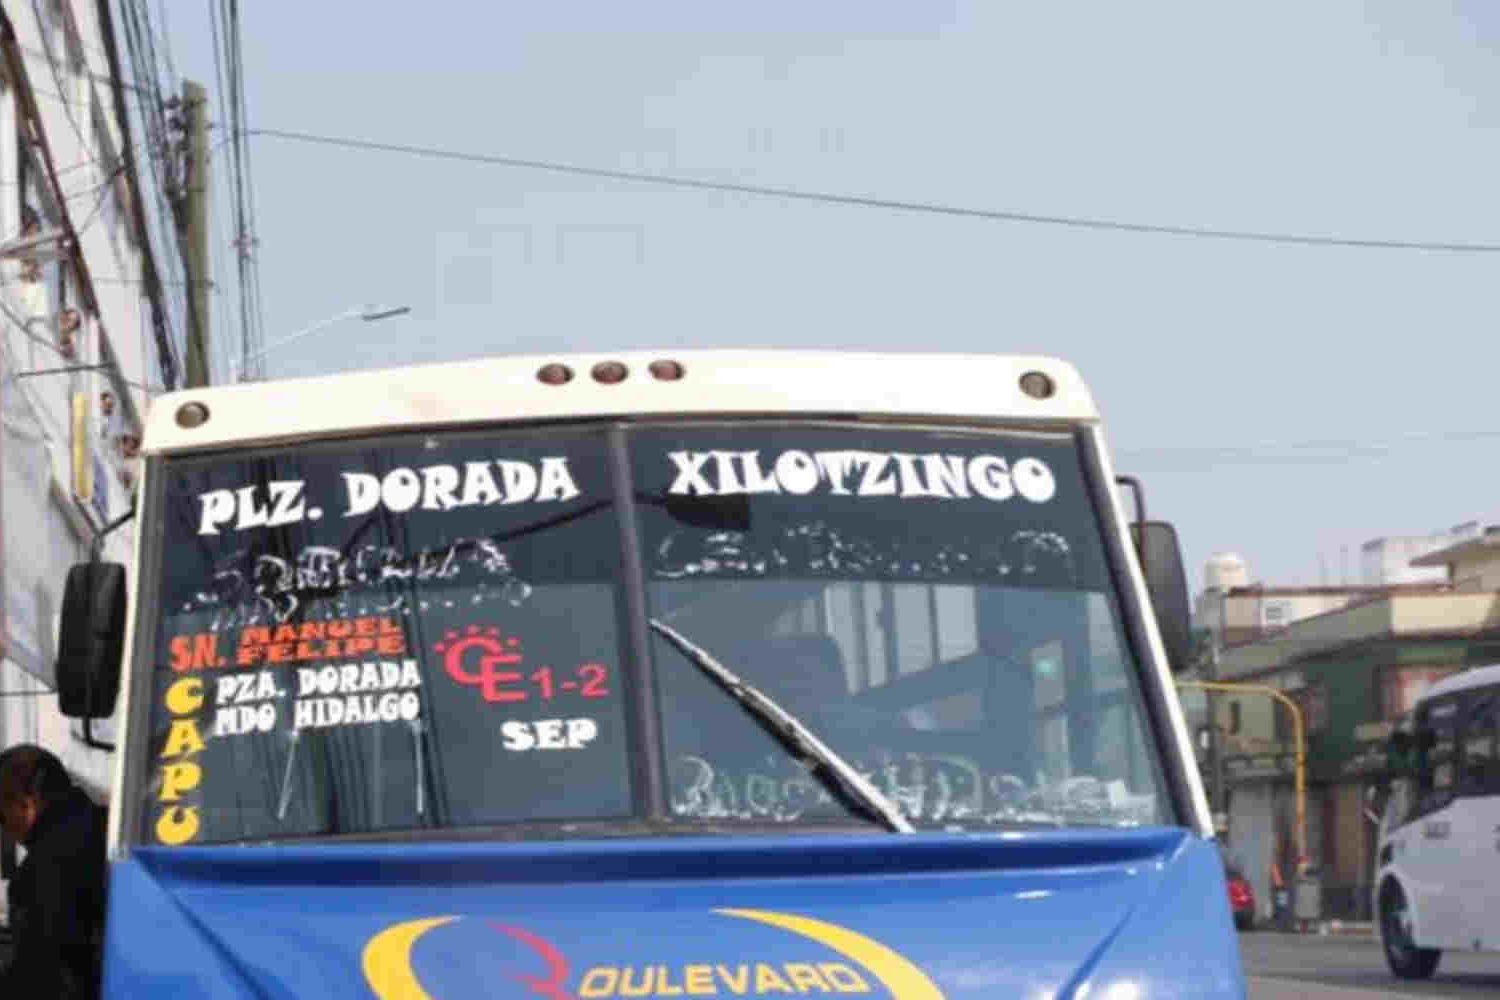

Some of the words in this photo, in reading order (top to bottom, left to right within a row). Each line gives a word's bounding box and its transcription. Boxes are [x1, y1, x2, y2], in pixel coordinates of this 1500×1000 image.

[197, 480, 323, 536] PLZ.
[341, 457, 580, 518] DORADA
[668, 449, 1057, 503] XILOTZINGO
[216, 670, 287, 704] PZA.
[298, 660, 421, 697] DORADA
[294, 691, 421, 729] HIDALGO
[501, 718, 598, 751] SEP
[156, 676, 208, 846] CAPU
